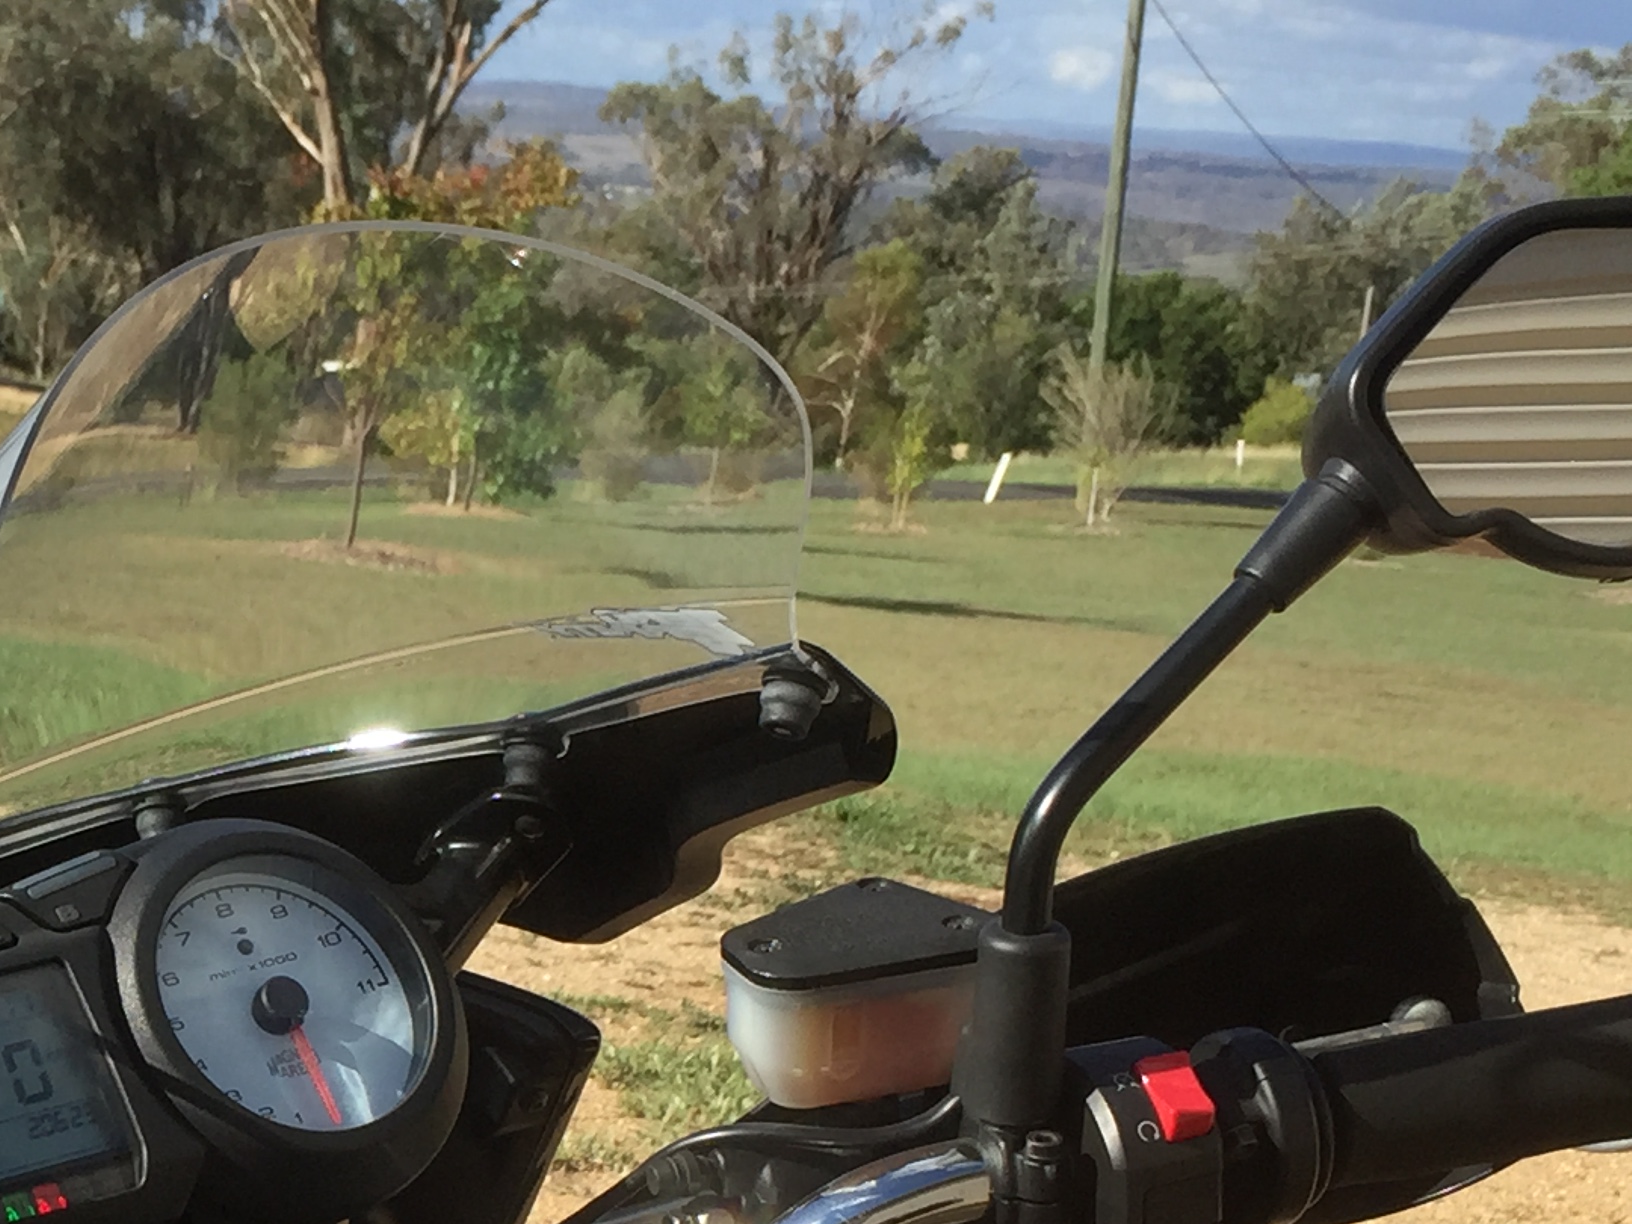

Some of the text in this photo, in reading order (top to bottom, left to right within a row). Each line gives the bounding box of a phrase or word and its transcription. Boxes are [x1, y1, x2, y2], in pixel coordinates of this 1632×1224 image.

[215, 903, 235, 919] 8
[270, 904, 289, 920] 9
[174, 930, 191, 948] 7
[317, 931, 343, 948] 10
[161, 971, 181, 987] 6
[356, 978, 376, 995] 11
[1, 1038, 54, 1106] 0
[295, 1111, 304, 1125] 1
